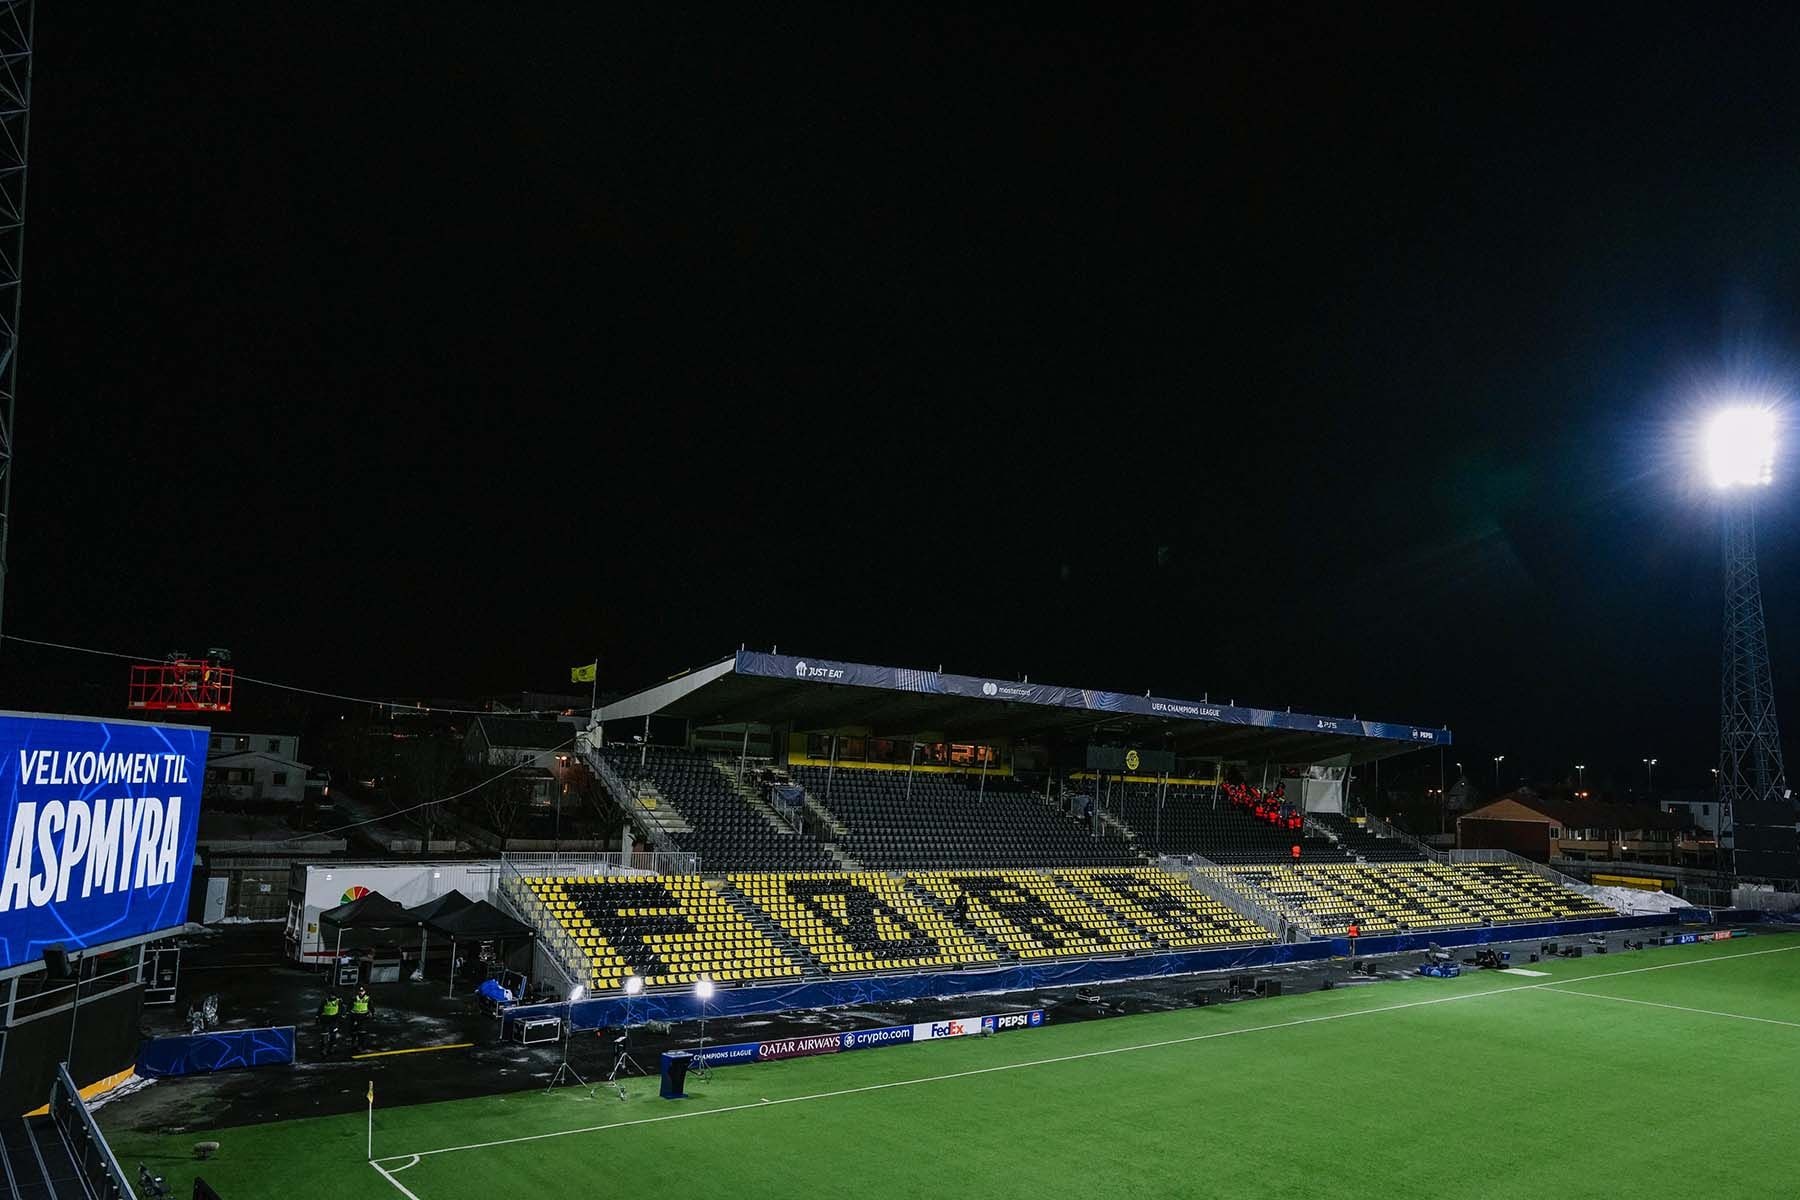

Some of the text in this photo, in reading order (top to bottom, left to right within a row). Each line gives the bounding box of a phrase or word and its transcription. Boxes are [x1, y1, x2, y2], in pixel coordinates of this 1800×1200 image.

[808, 667, 844, 679] JUST EAT
[1151, 702, 1221, 717] UEFA CHAMPIONS LEAGUE
[20, 750, 188, 785] VELKOMMEN TIL
[0, 796, 182, 912] ASPMYRA
[931, 1021, 965, 1037] FedEx
[998, 1014, 1028, 1028] PEPSI
[857, 1028, 911, 1045] crypto.com
[729, 1049, 753, 1058] LEAGUE
[759, 1036, 841, 1057] QATAR AIRWAYS
